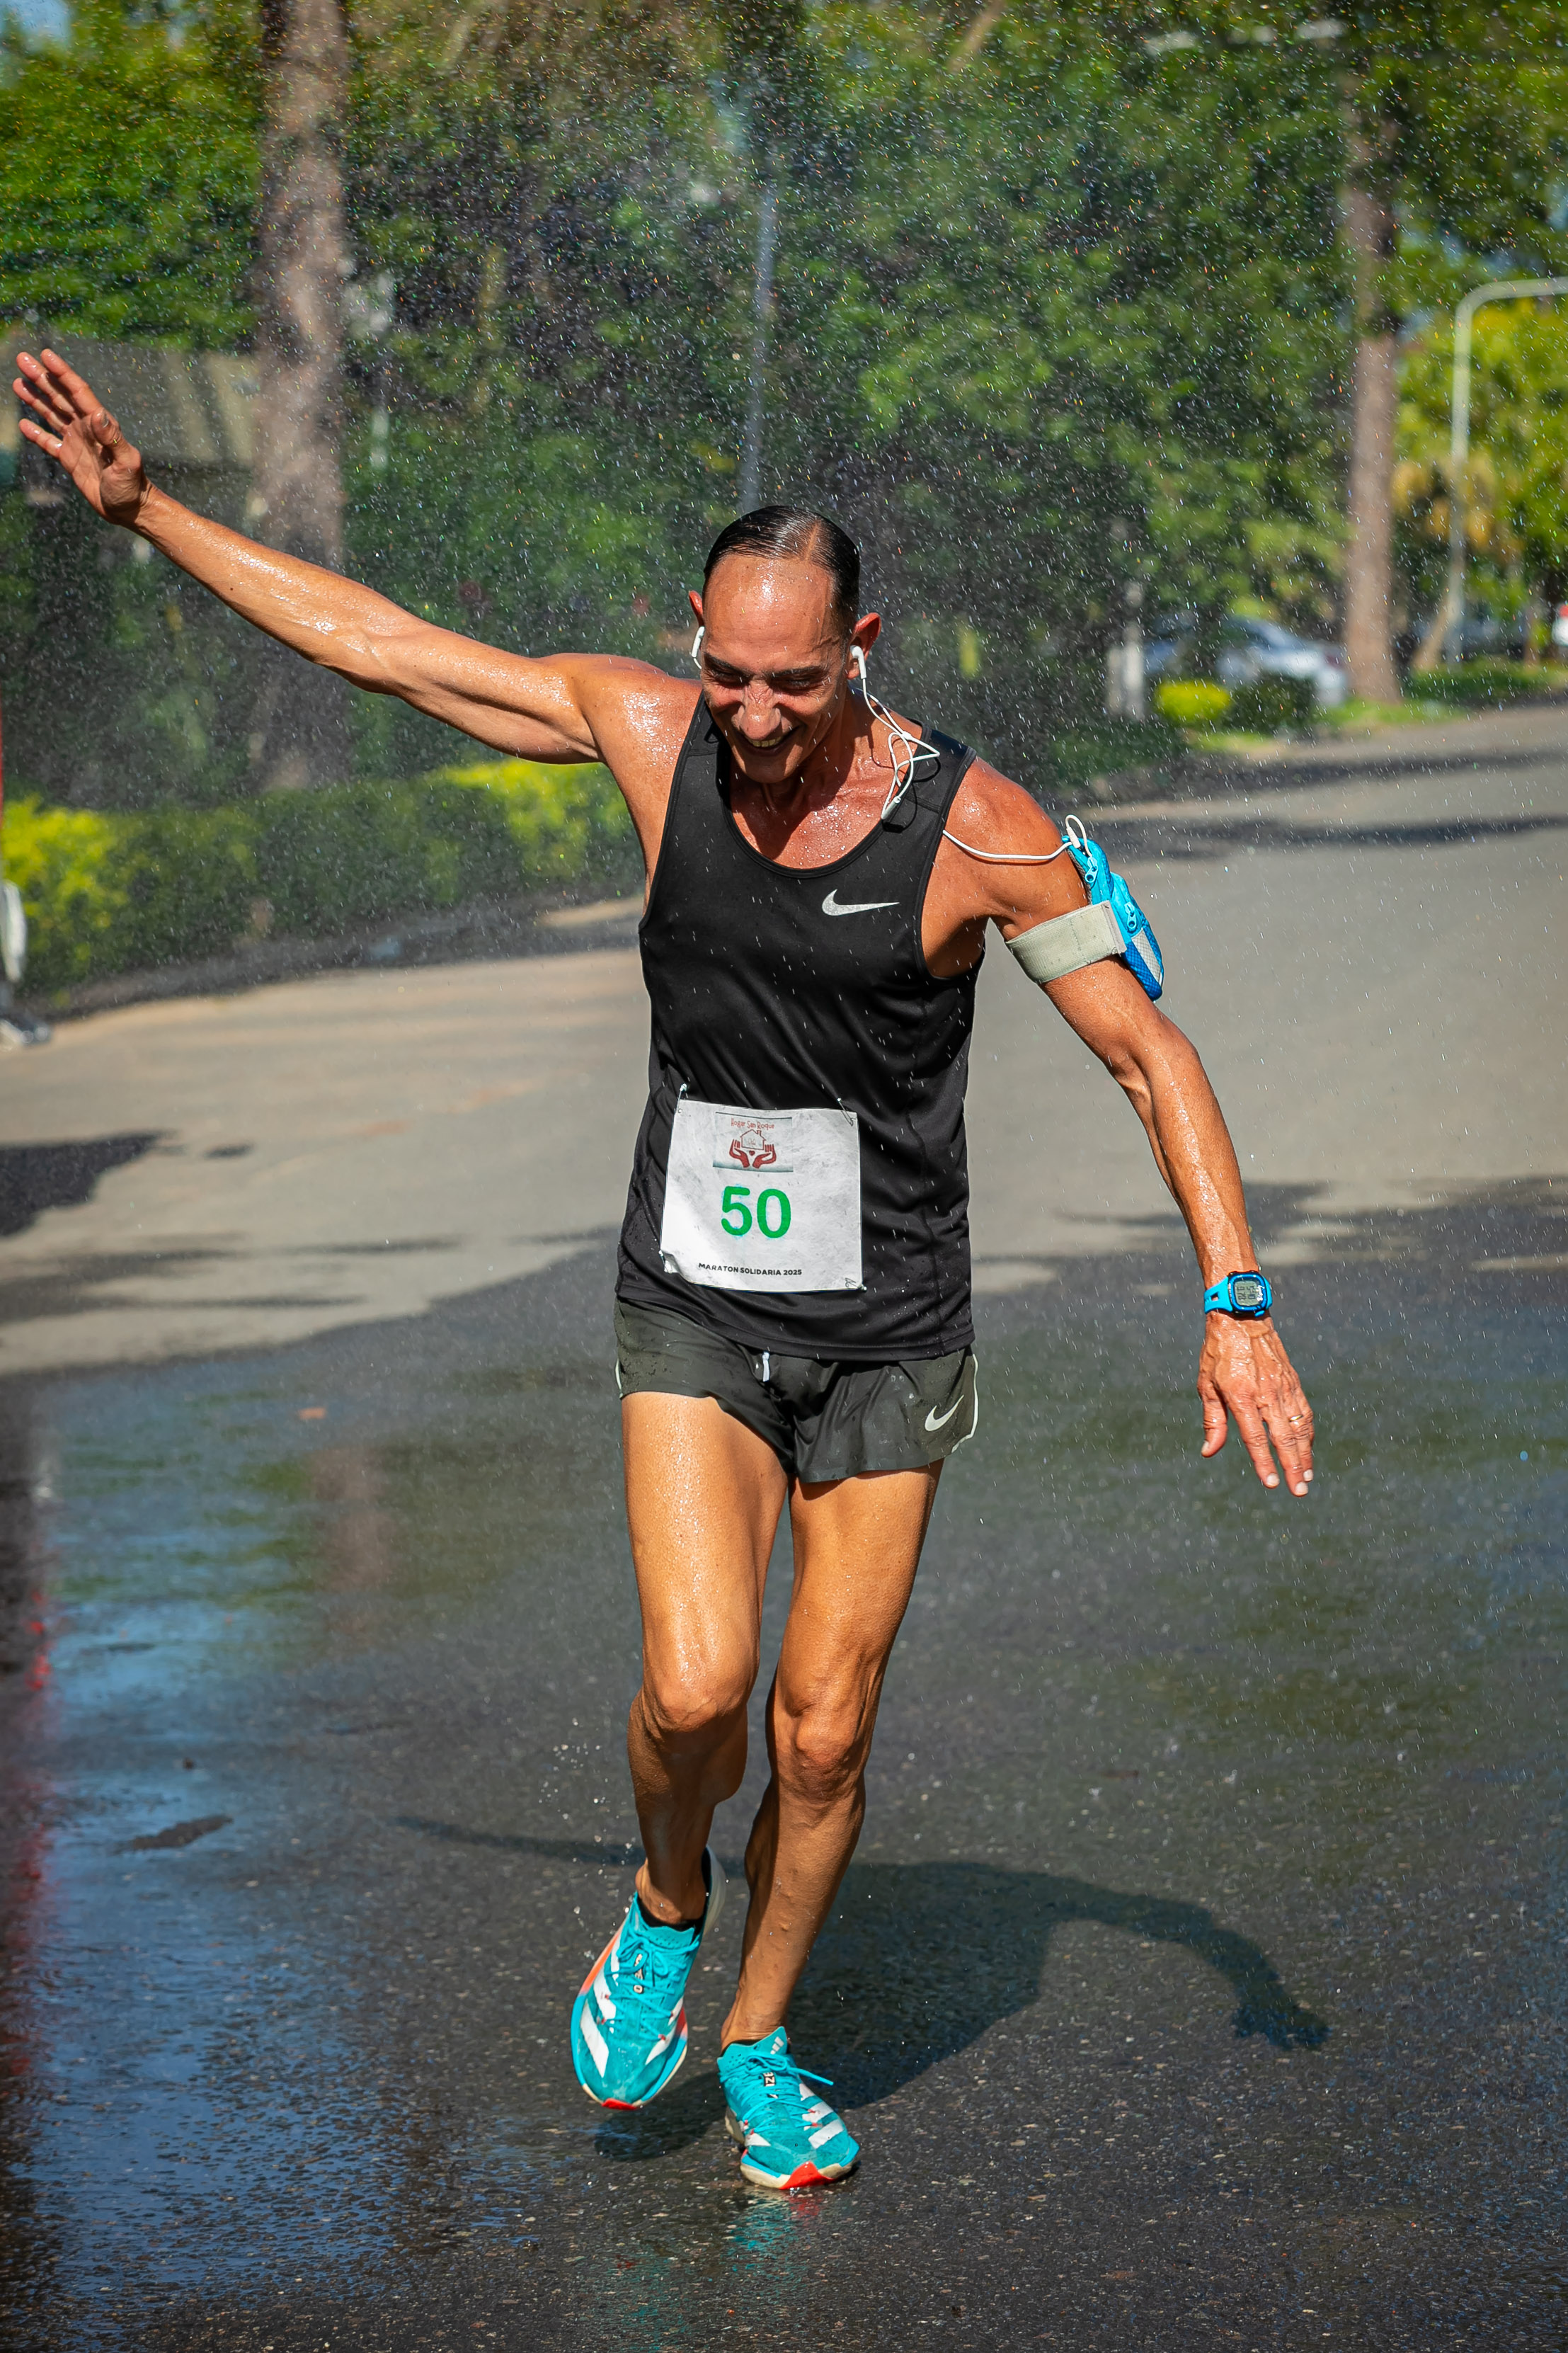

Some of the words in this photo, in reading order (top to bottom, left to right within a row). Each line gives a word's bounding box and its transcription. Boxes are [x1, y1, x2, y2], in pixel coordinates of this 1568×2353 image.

[731, 1117, 745, 1128] Hogar
[747, 1120, 756, 1129] San
[757, 1121, 774, 1131] Roque
[721, 1185, 791, 1238] 50
[698, 1263, 738, 1273] MARATON
[740, 1267, 782, 1275] SOLIDARIA
